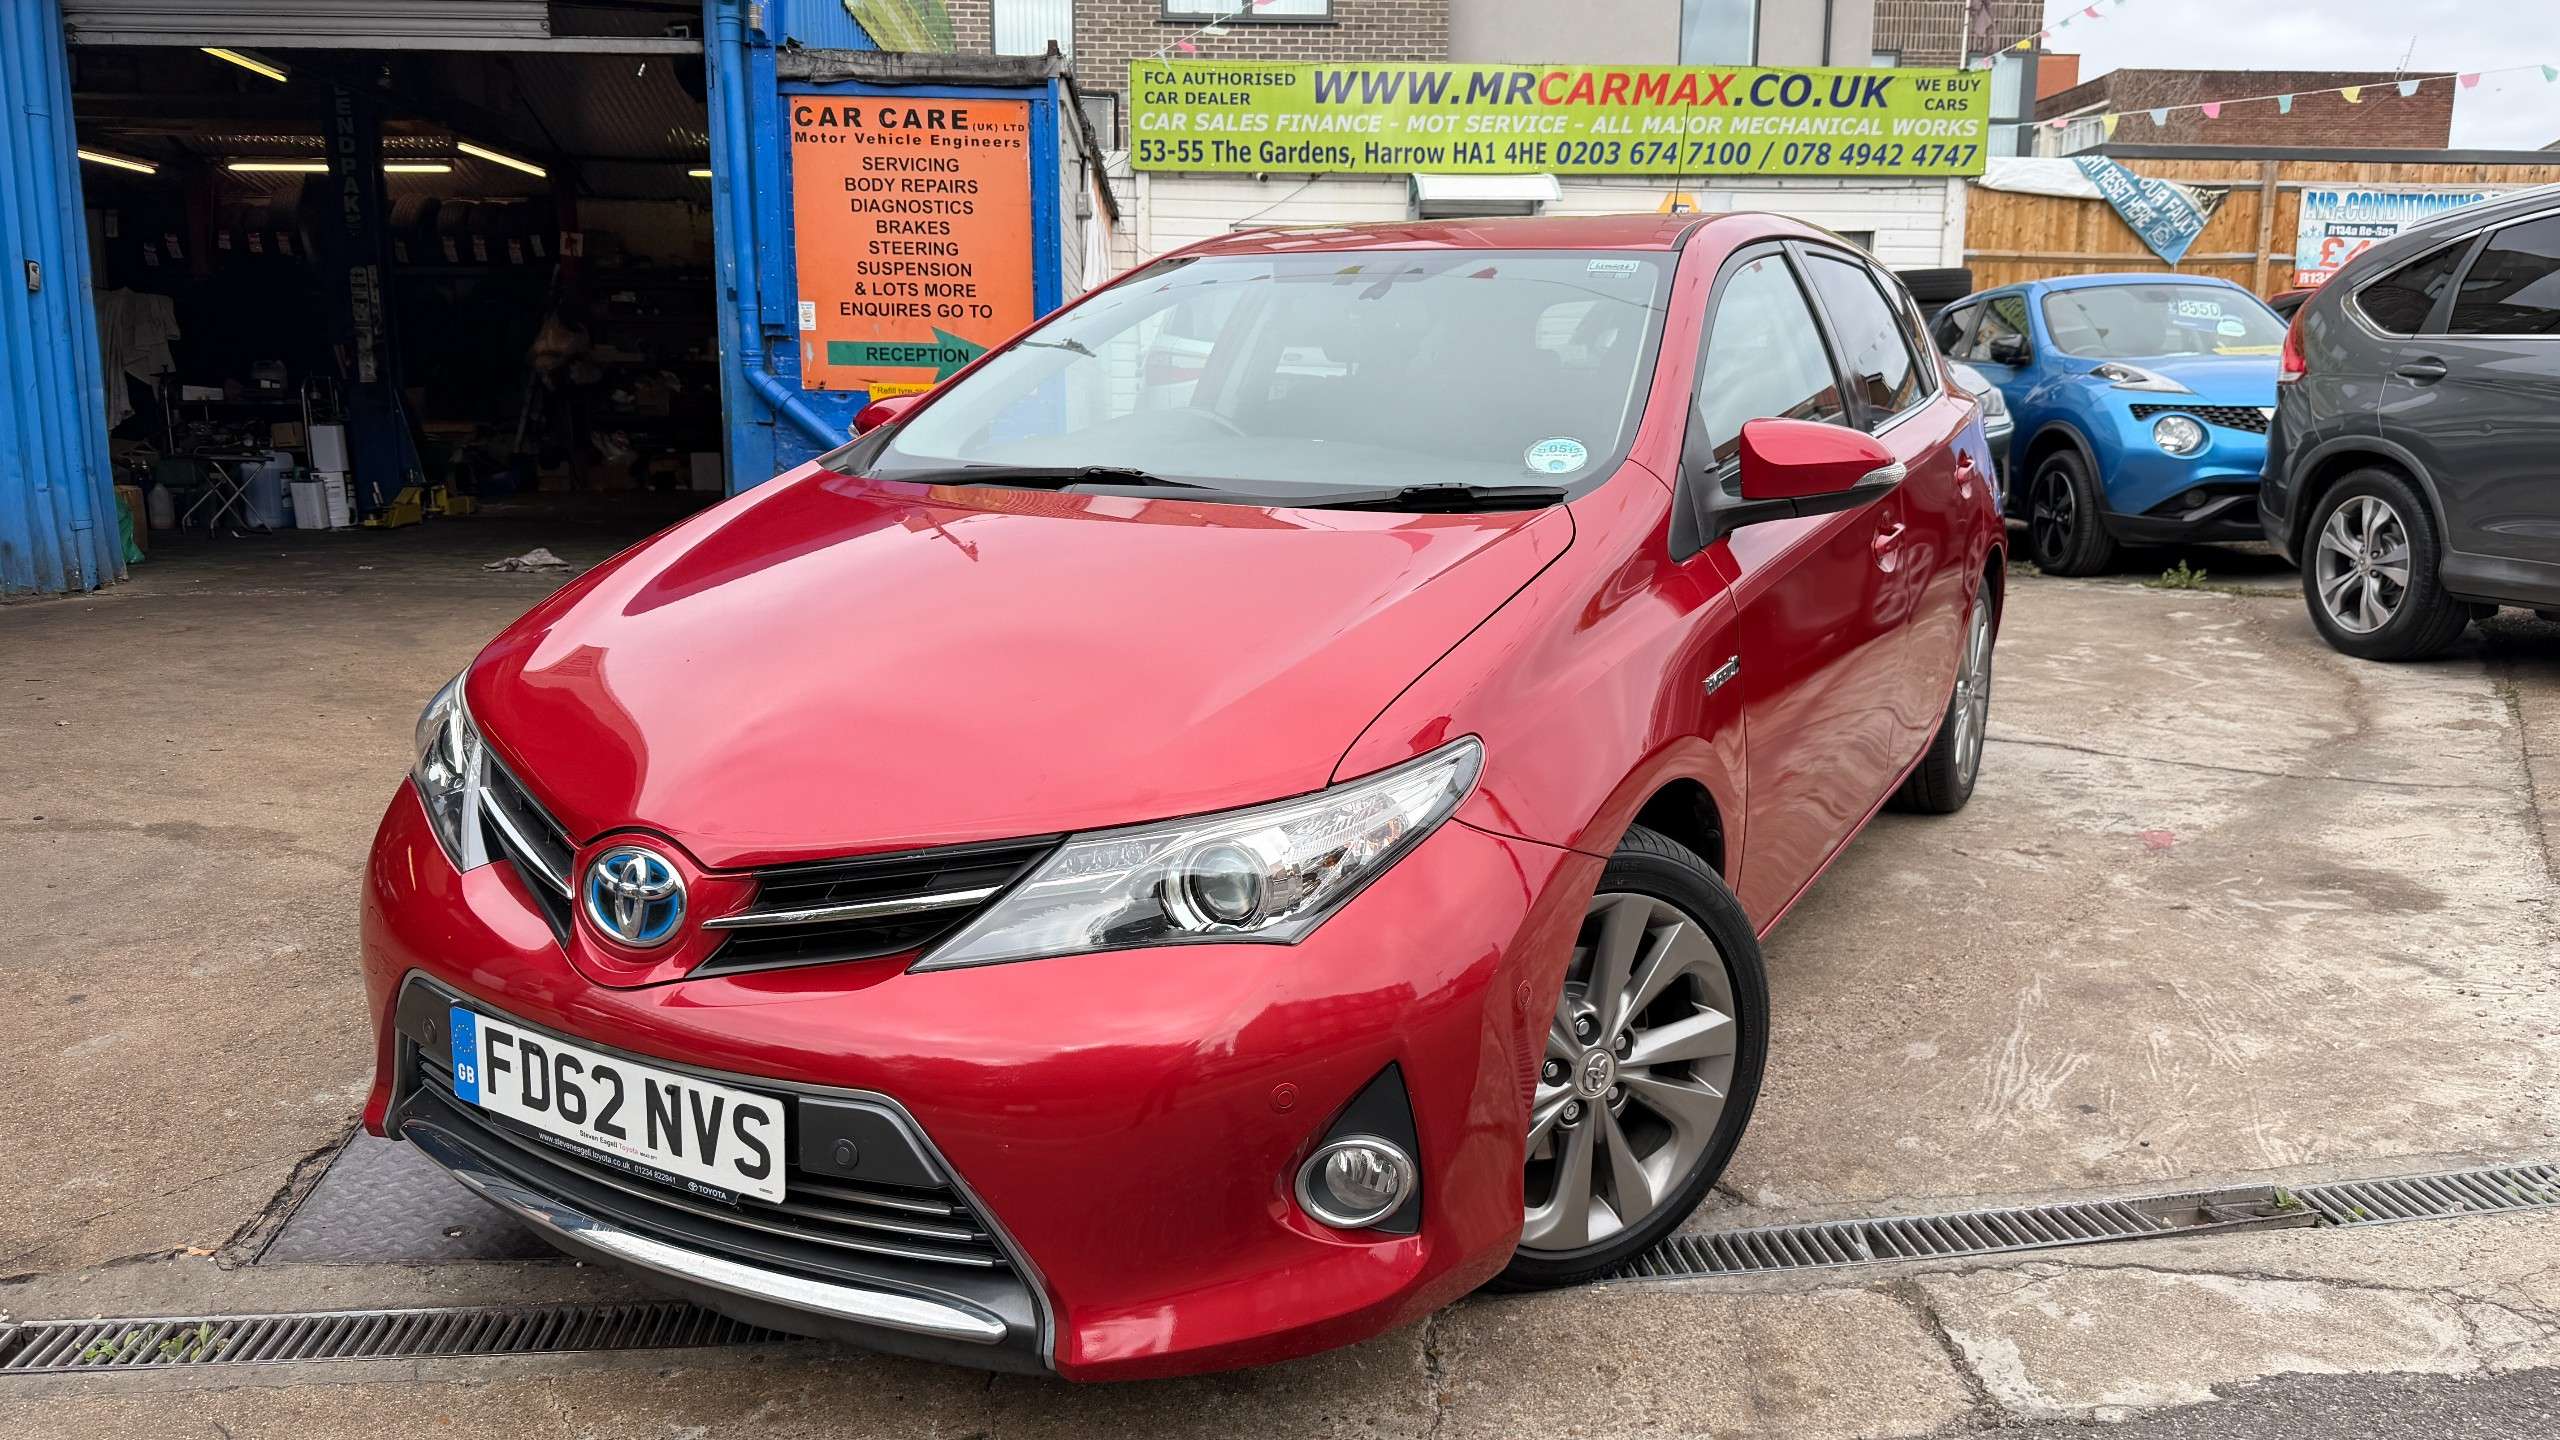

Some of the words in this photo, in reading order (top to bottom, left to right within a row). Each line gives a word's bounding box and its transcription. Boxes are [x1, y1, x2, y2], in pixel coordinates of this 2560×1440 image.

[1144, 71, 1176, 85] FCA
[1183, 72, 1296, 86] AUTHORISED
[1915, 79, 1940, 92] WE
[1947, 79, 1981, 92] BUY
[1144, 91, 1178, 105] CAR
[1185, 92, 1251, 105] DEALER
[1314, 71, 1895, 108] WWW.MRCARMAX.CO.UK
[1924, 98, 1968, 111] CARS
[794, 106, 862, 128] CAR
[879, 108, 968, 130] CARE
[972, 122, 998, 132] (UK)
[1003, 124, 1025, 132] LTD
[1139, 112, 1187, 131] CAR
[1194, 113, 1269, 132] SALES
[1276, 113, 1383, 133] FINANCE
[1406, 115, 1460, 133] MOT
[1465, 115, 1568, 134] SERVICE
[1590, 116, 1633, 134] ALL
[1641, 116, 1723, 135] MAJOR
[1729, 116, 1883, 136] MECHANICAL
[1892, 118, 1979, 137] WORKS
[794, 132, 846, 143] Motor
[854, 132, 922, 146] Vehicle
[930, 134, 1021, 149] Engineers
[1139, 139, 1203, 163] 53-55
[1212, 139, 1252, 163] The
[1259, 140, 1356, 169] Gardens,
[1365, 141, 1445, 164] Harrow
[1453, 141, 1496, 165] HA1
[1504, 141, 1547, 165] 4HE
[1556, 141, 1622, 165] 0203
[1629, 141, 1678, 165] 674
[1686, 141, 1751, 165] 7100
[1758, 141, 1776, 170] /
[1782, 142, 1832, 166] 078
[1839, 143, 1904, 167] 4942
[1911, 143, 1978, 167] 4747
[862, 156, 960, 172] SERVICING
[844, 177, 895, 192] BODY
[901, 178, 978, 194] REPAIRS
[2096, 165, 2136, 203] RESET
[2122, 196, 2157, 228] HERE
[851, 198, 974, 215] DIAGNOSTICS
[2134, 175, 2171, 207] OUR
[2162, 198, 2201, 236] FAULT
[876, 219, 950, 235] BRAKES
[869, 240, 959, 256] STEERING
[857, 261, 972, 277] SUSPENSION
[855, 281, 866, 296] &
[872, 282, 919, 297] LOTS
[925, 283, 977, 298] MORE
[840, 302, 931, 318] ENQUIRES
[937, 304, 964, 318] GO
[969, 305, 993, 319] TO
[866, 346, 969, 362] RECEPTION
[458, 1062, 474, 1084] GB
[485, 1026, 627, 1140] FD62
[644, 1077, 771, 1181] NVS
[580, 1130, 599, 1142] Steven
[619, 1144, 639, 1155] Toyota
[698, 1185, 727, 1200] TOYOTA
